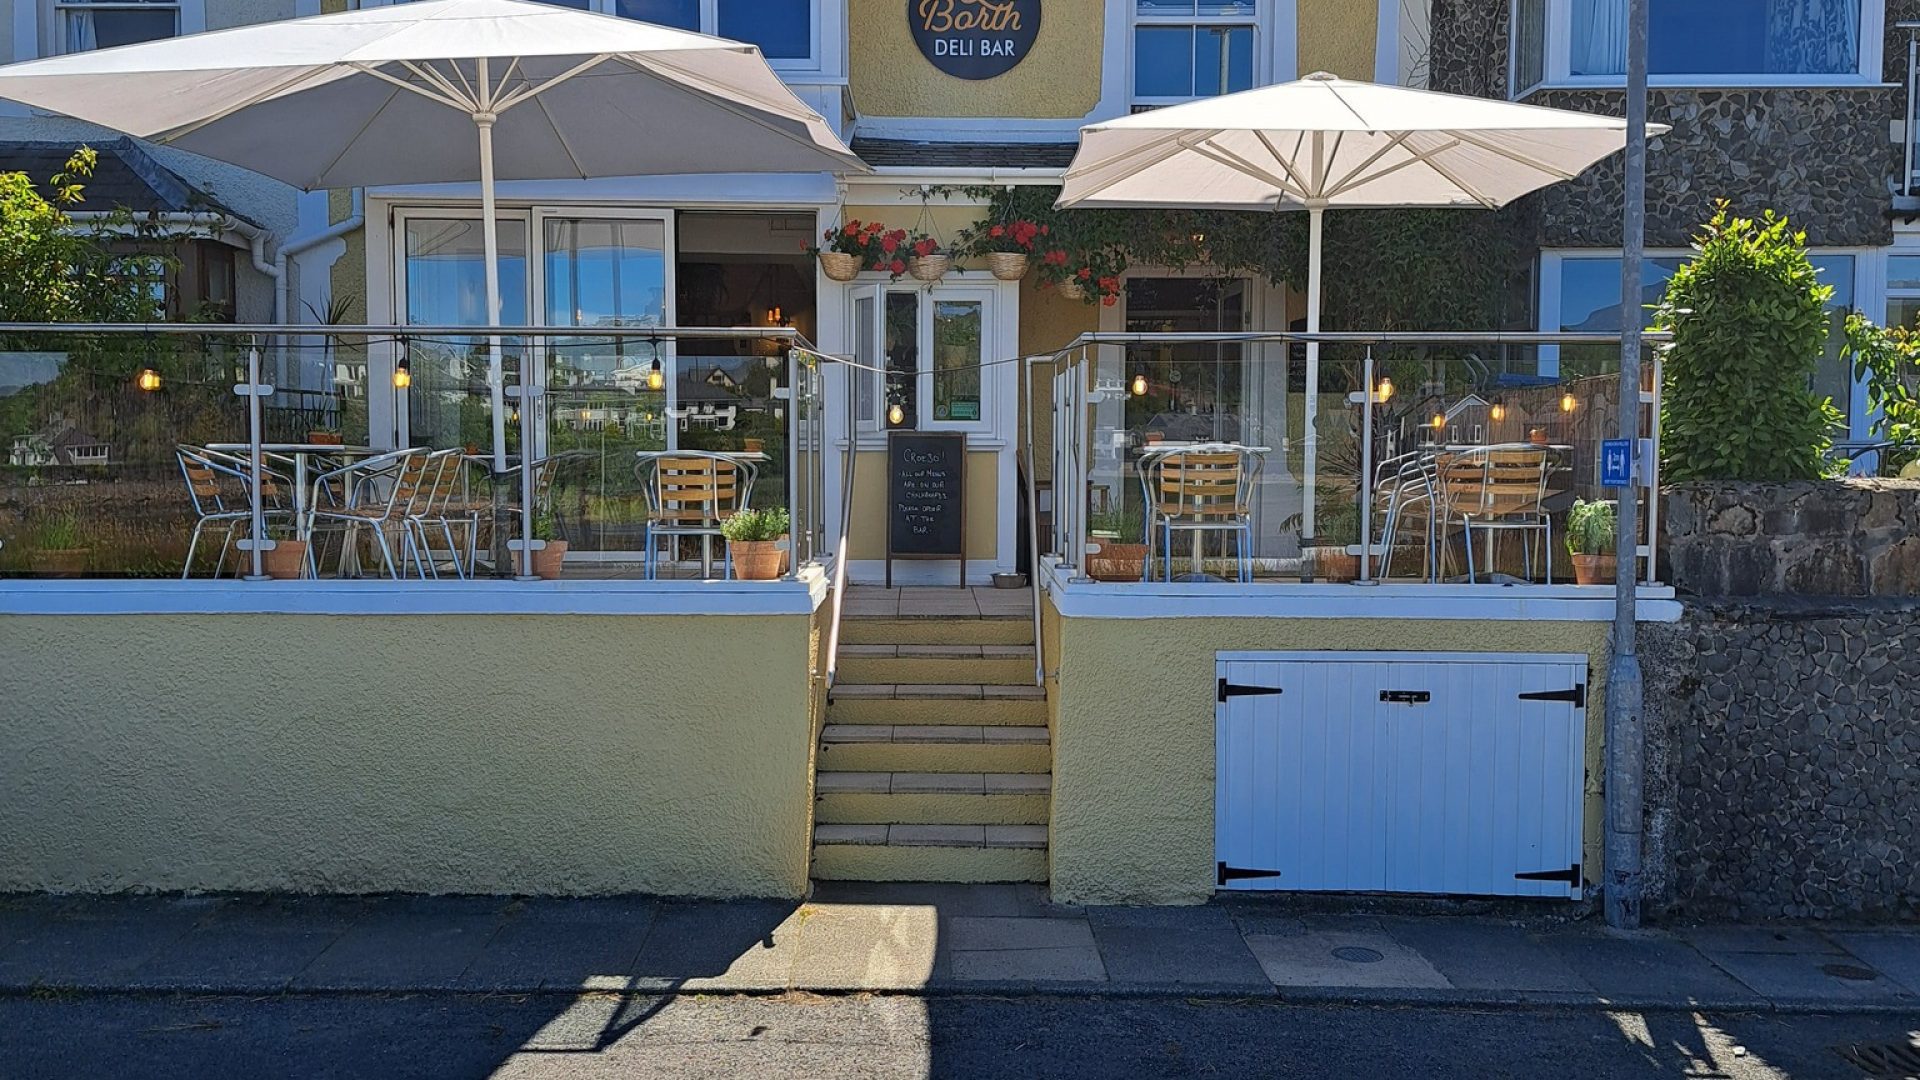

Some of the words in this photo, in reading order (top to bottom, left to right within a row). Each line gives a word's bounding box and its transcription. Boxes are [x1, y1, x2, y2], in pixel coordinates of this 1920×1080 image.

[919, 0, 1022, 32] Borth
[934, 39, 973, 56] DELI
[980, 39, 1015, 56] BAR
